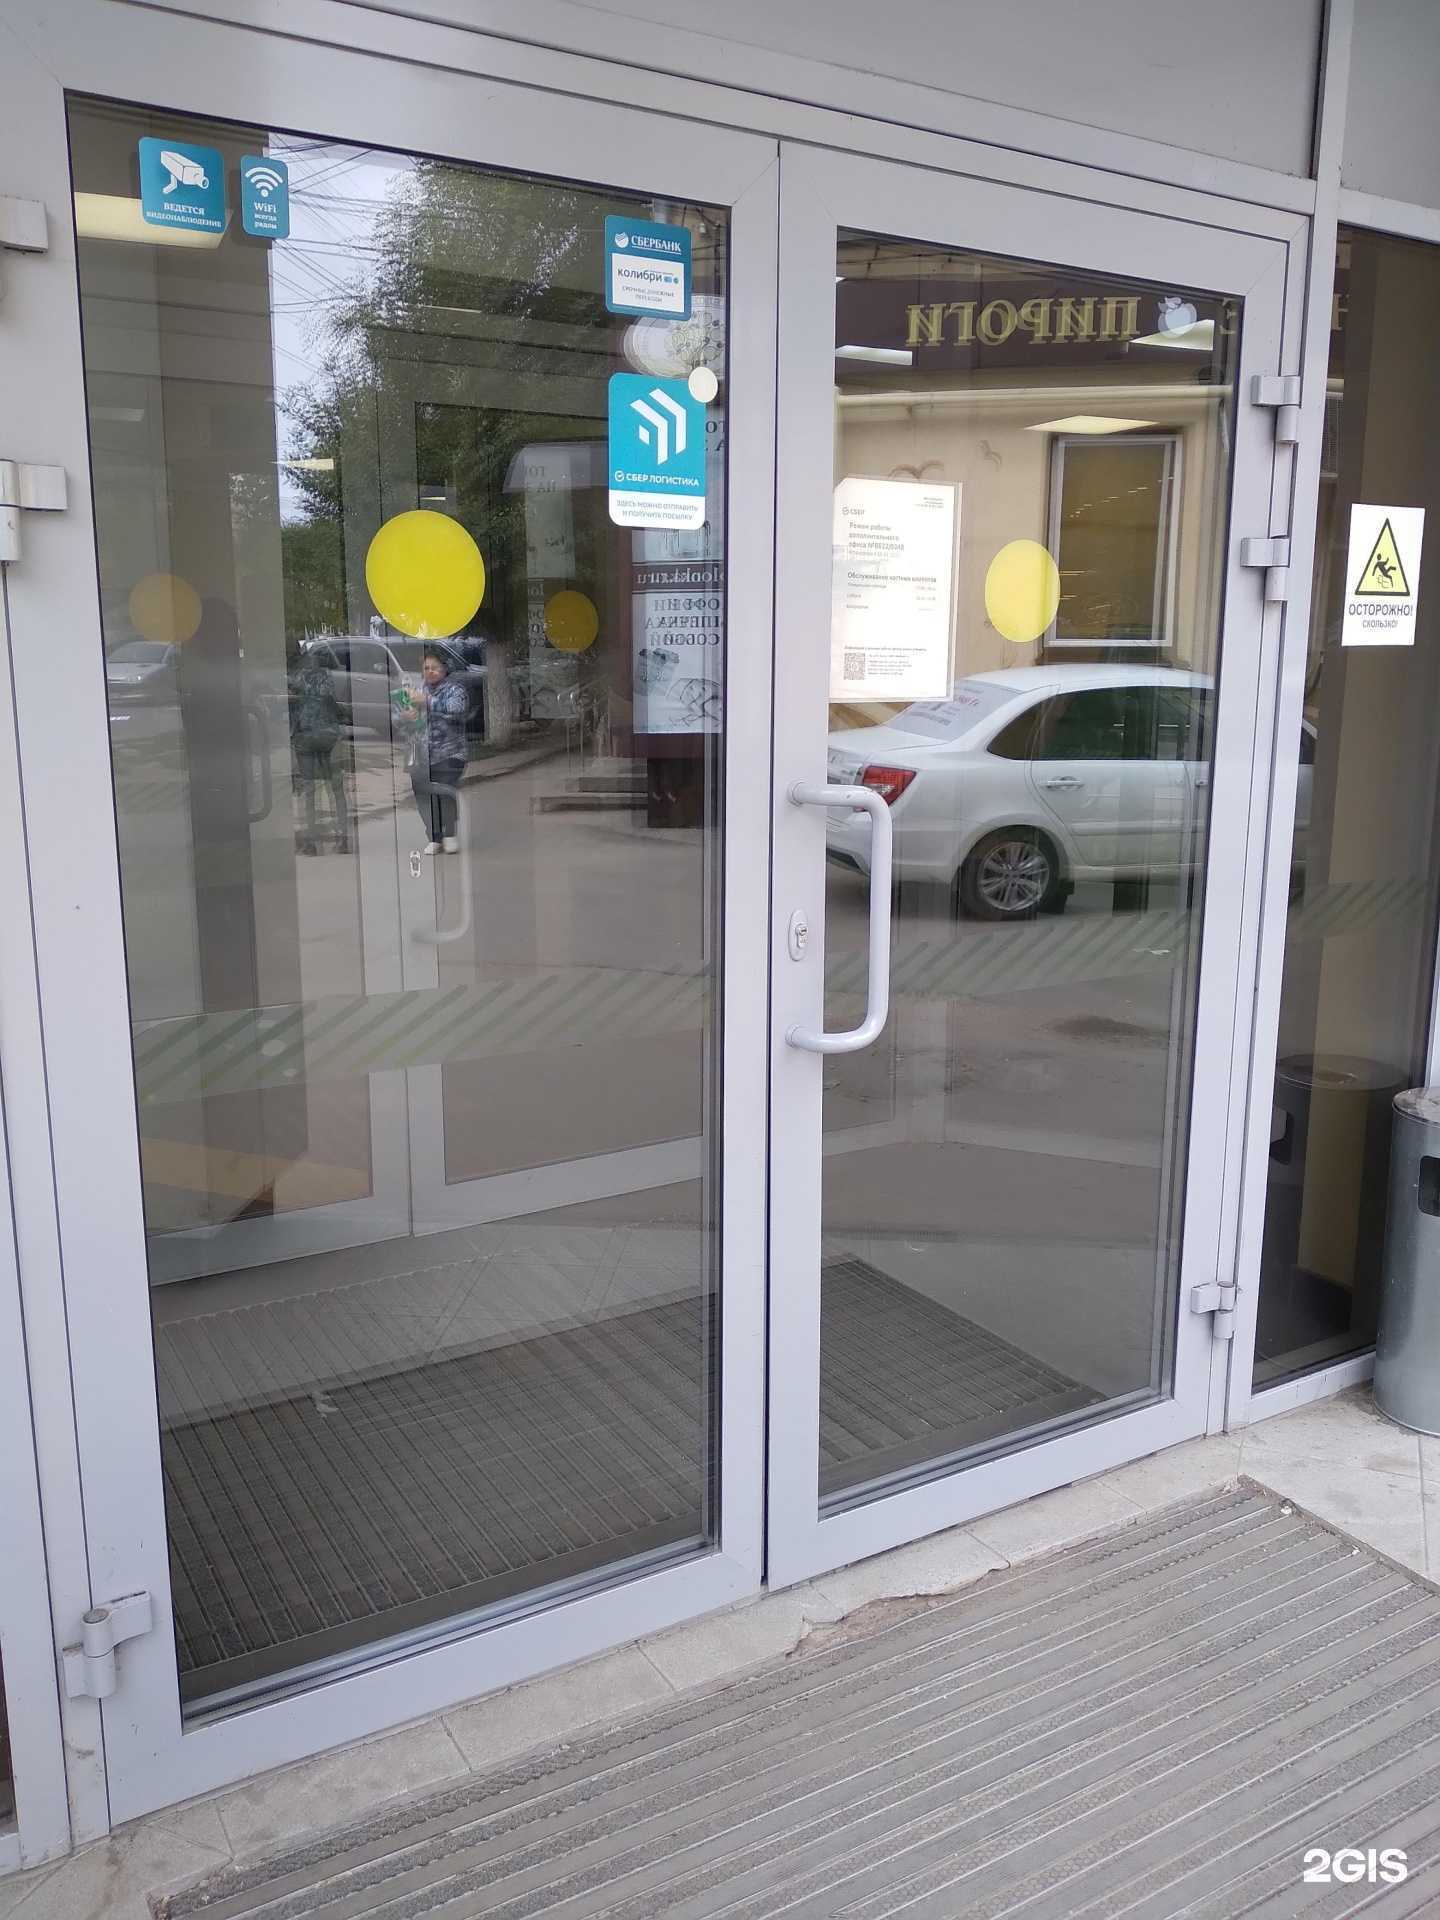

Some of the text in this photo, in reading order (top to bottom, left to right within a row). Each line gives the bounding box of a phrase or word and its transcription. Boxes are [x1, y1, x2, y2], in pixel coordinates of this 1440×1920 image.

[163, 202, 205, 215] ВЕДЕТСЯ
[254, 202, 277, 213] WiFi
[146, 211, 222, 228] ВИДЕОНАБЛЮДЕНИЕ
[631, 235, 681, 252] СБЕРБАНК
[617, 267, 662, 284] колибри
[626, 474, 700, 487] СБЕР ЛОГИСТИКА
[1348, 604, 1413, 616] ОСТОРОЖНО!
